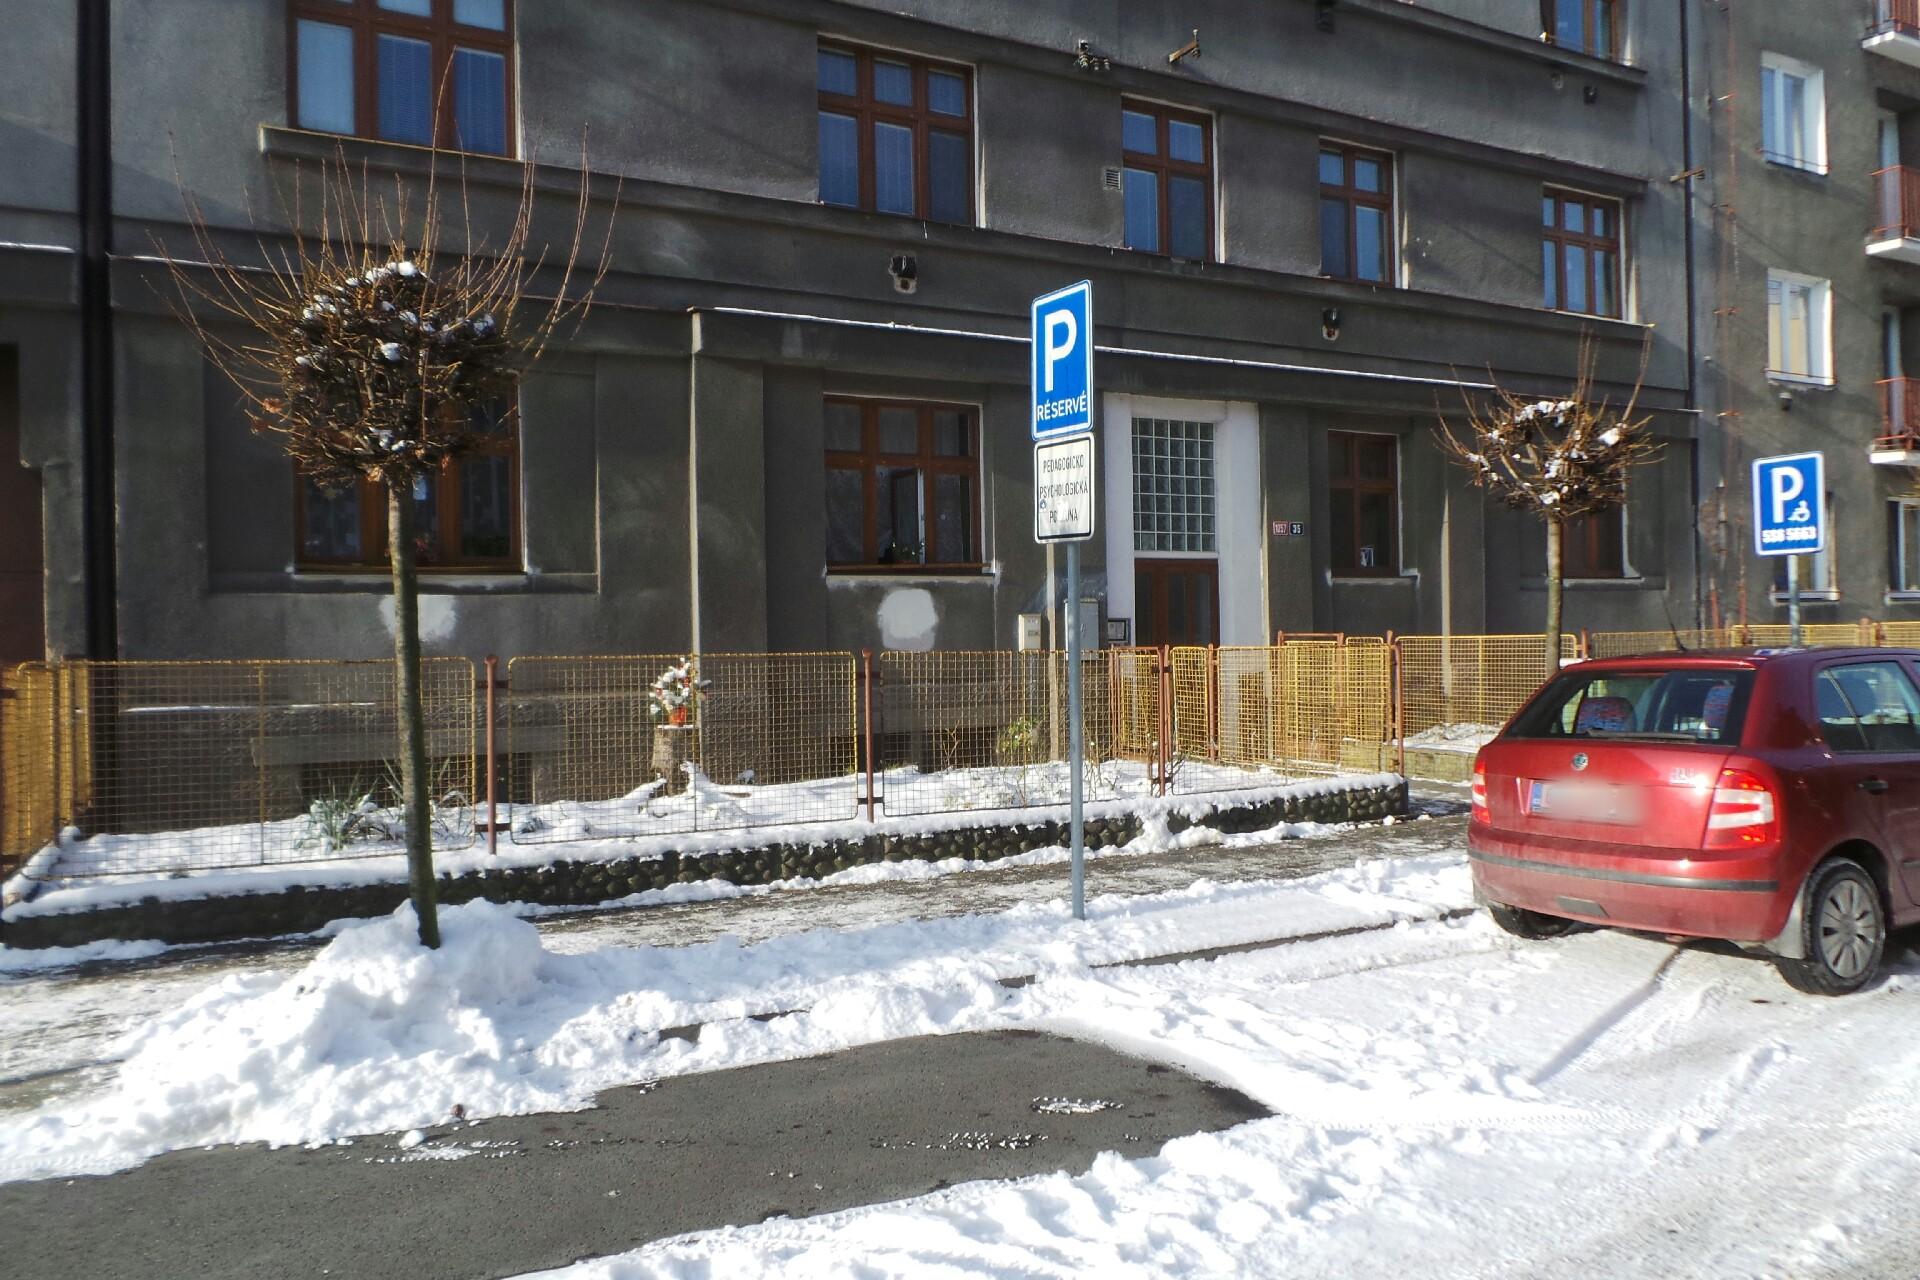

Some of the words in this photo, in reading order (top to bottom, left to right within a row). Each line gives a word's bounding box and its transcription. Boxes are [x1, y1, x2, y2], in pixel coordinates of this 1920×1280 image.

[1045, 309, 1077, 392] P
[1037, 390, 1087, 422] RÉSERVÉ
[1042, 454, 1085, 473] PEDAGOGICKO
[1771, 466, 1804, 524] P
[1292, 524, 1301, 534] 35
